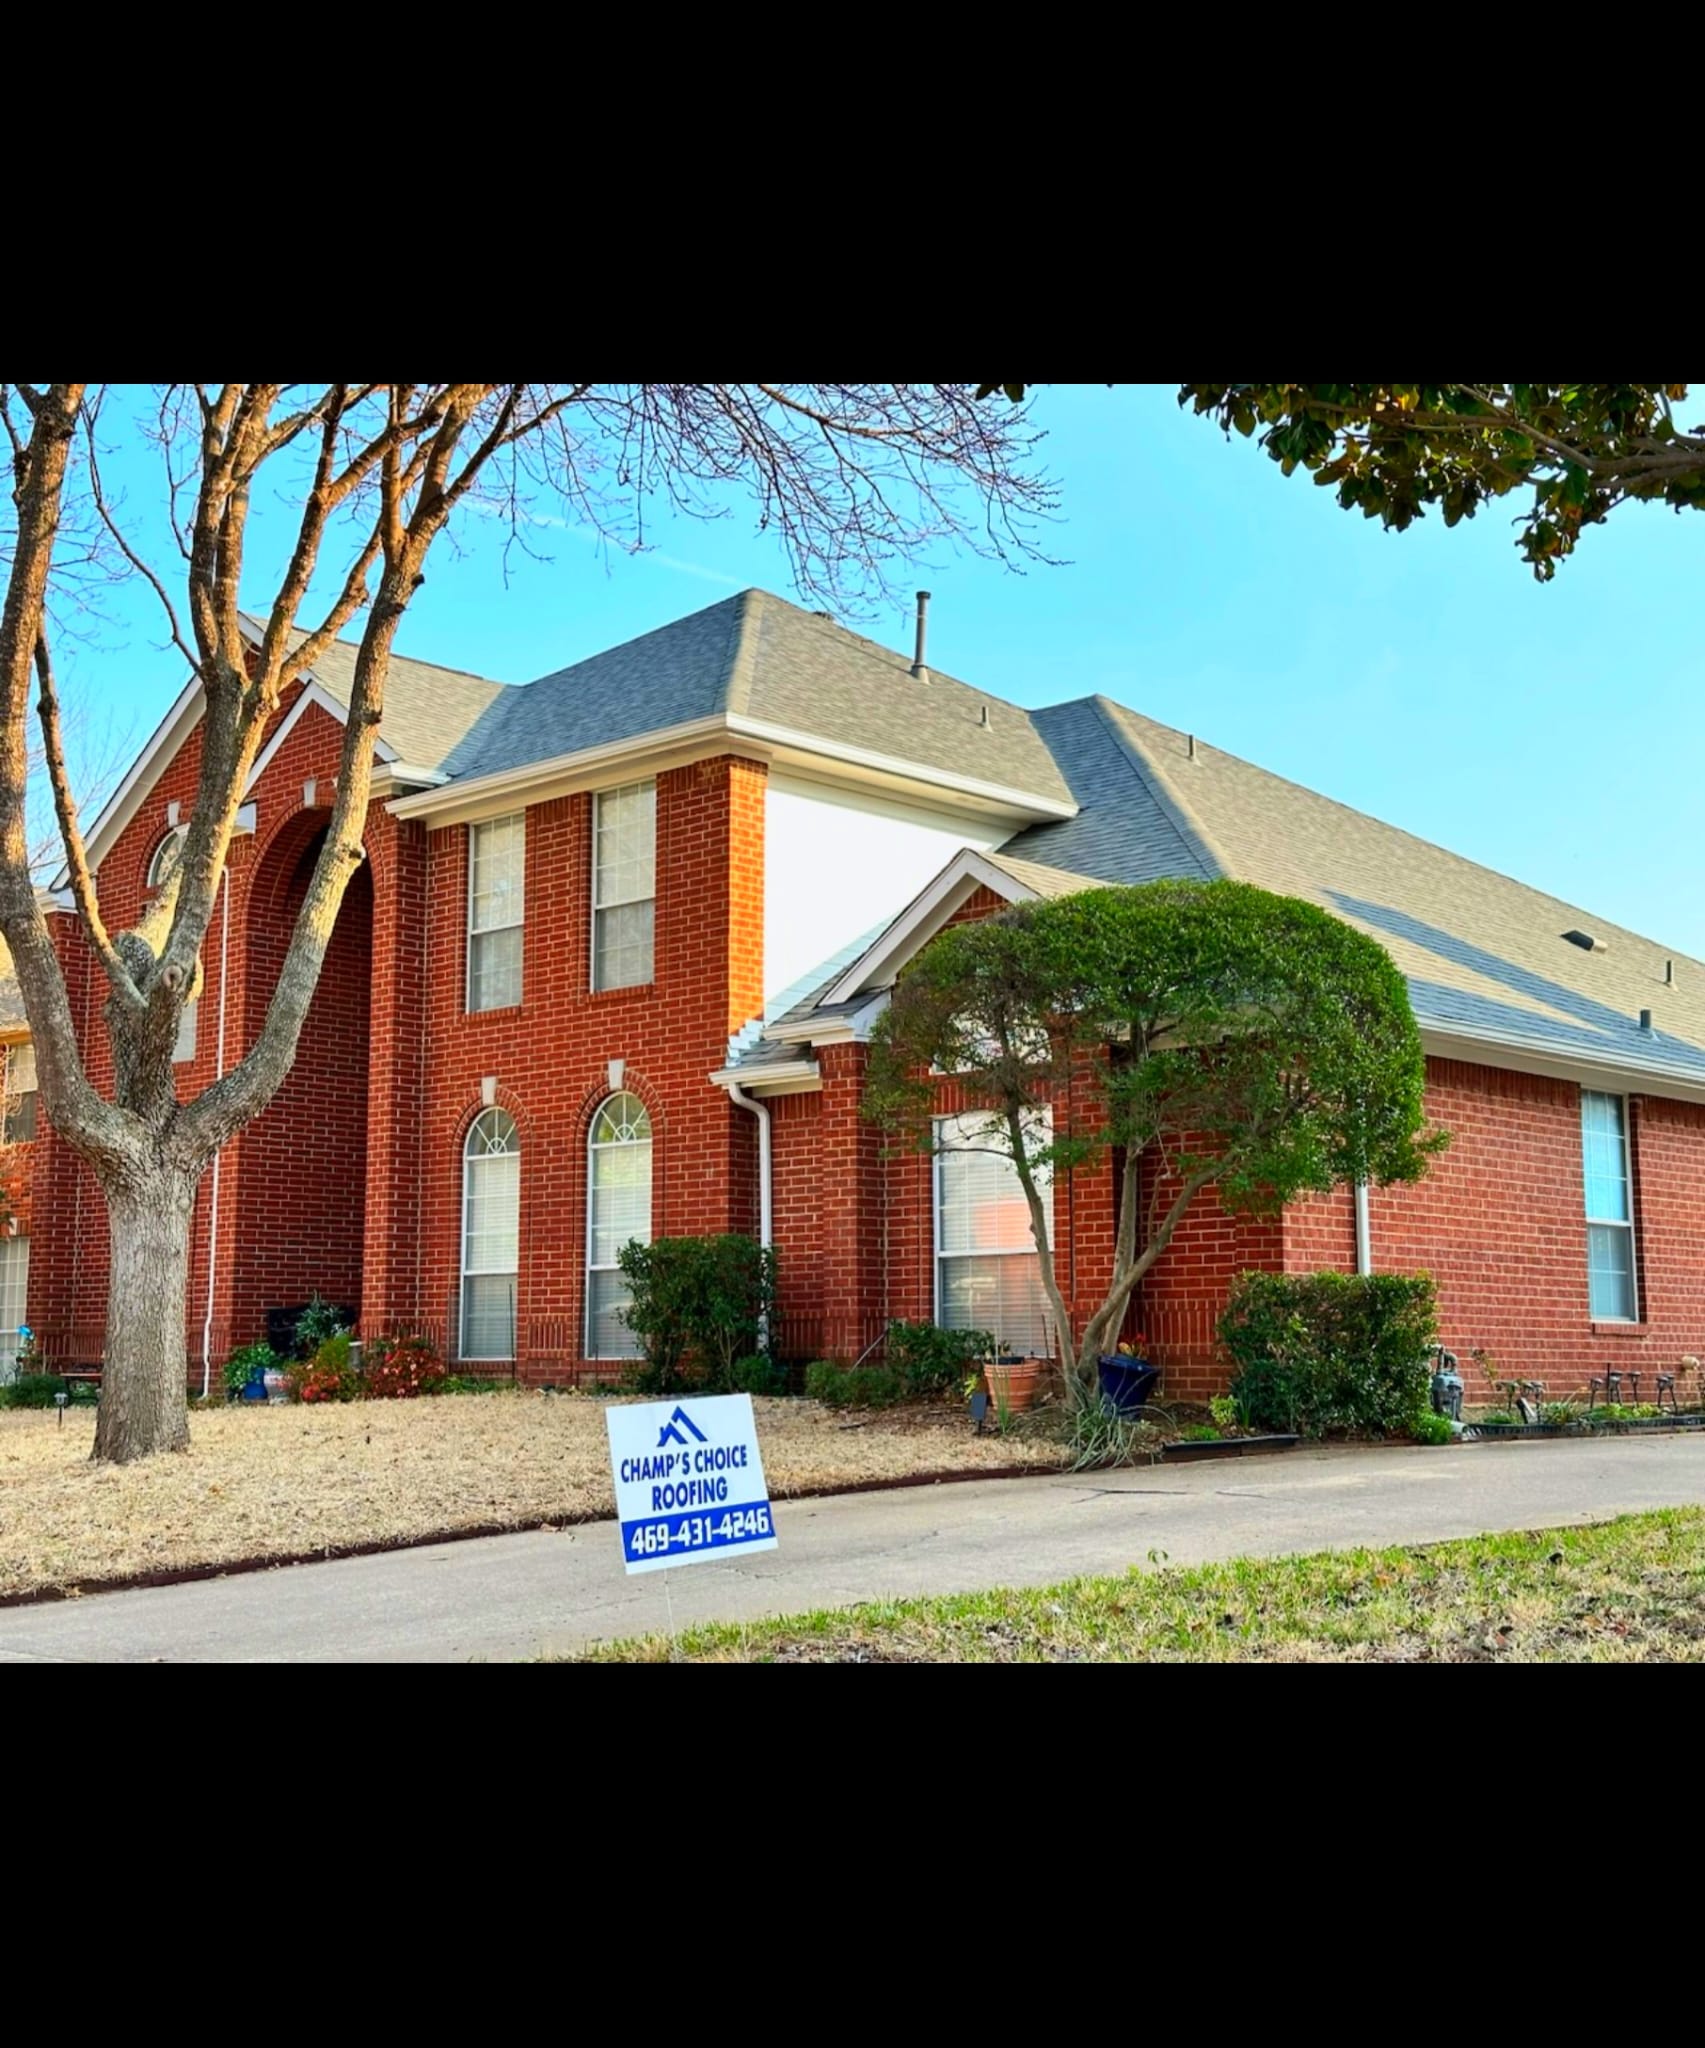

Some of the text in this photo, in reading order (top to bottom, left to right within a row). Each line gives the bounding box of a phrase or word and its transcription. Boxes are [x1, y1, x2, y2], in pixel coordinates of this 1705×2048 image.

[621, 1444, 748, 1483] CHAMP'S CHOICE
[652, 1476, 728, 1511] ROOFING
[631, 1508, 769, 1555] 469-431-4246
